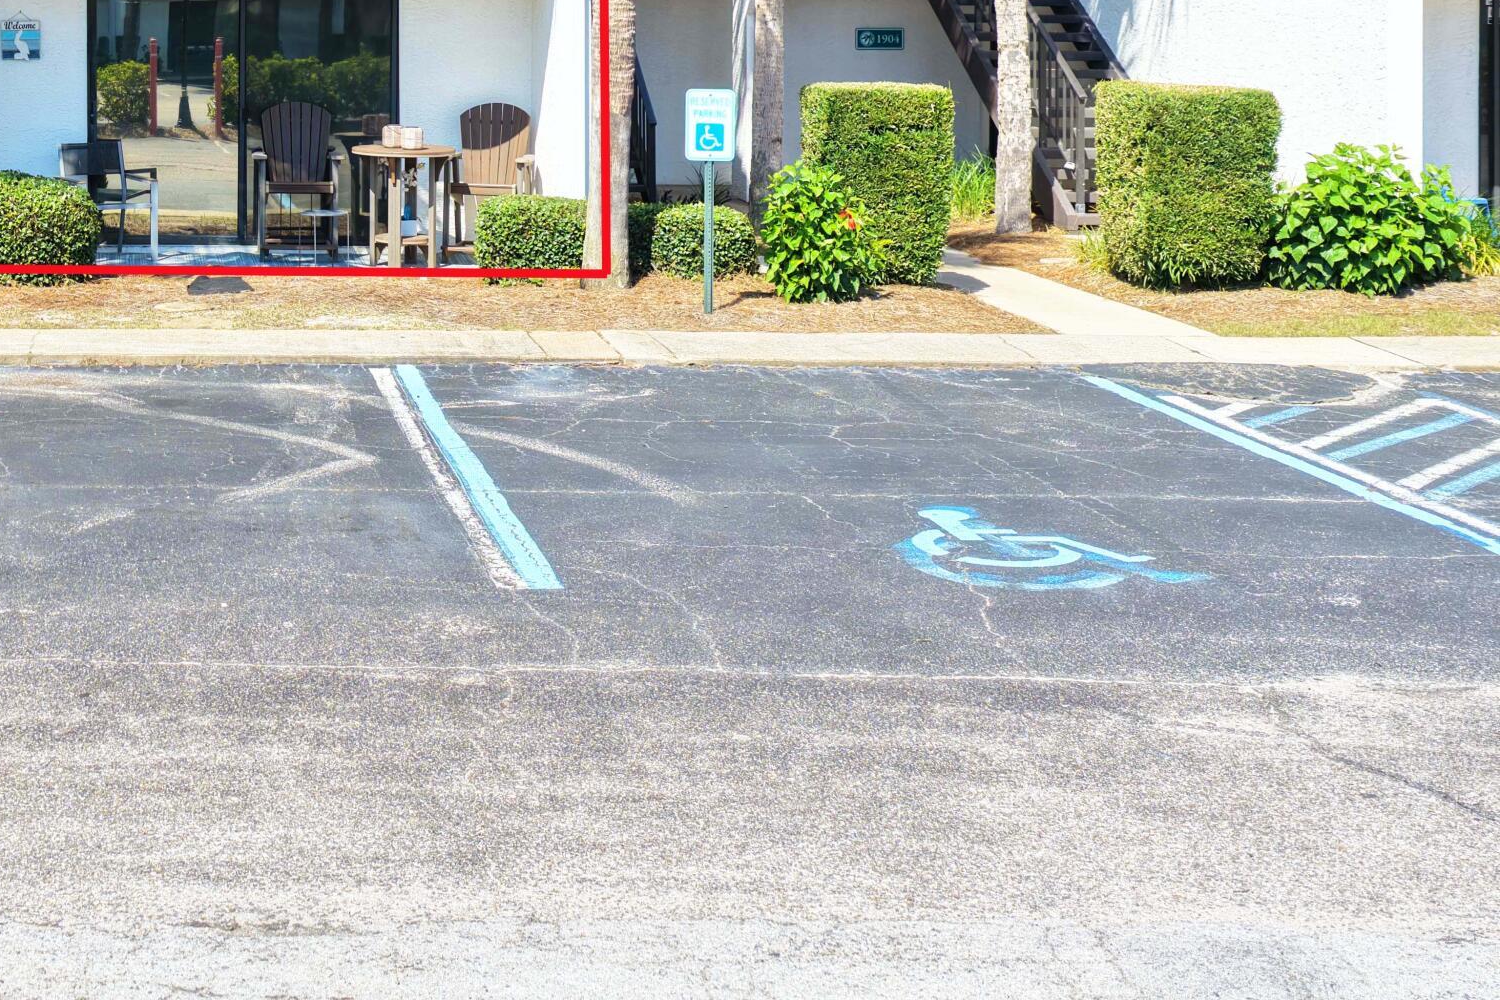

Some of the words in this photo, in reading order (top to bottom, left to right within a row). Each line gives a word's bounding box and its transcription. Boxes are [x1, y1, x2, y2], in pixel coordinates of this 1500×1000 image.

[4, 21, 36, 30] Welcome
[876, 34, 900, 44] 1904
[689, 96, 731, 106] RESERVED
[693, 109, 727, 118] PARKING
